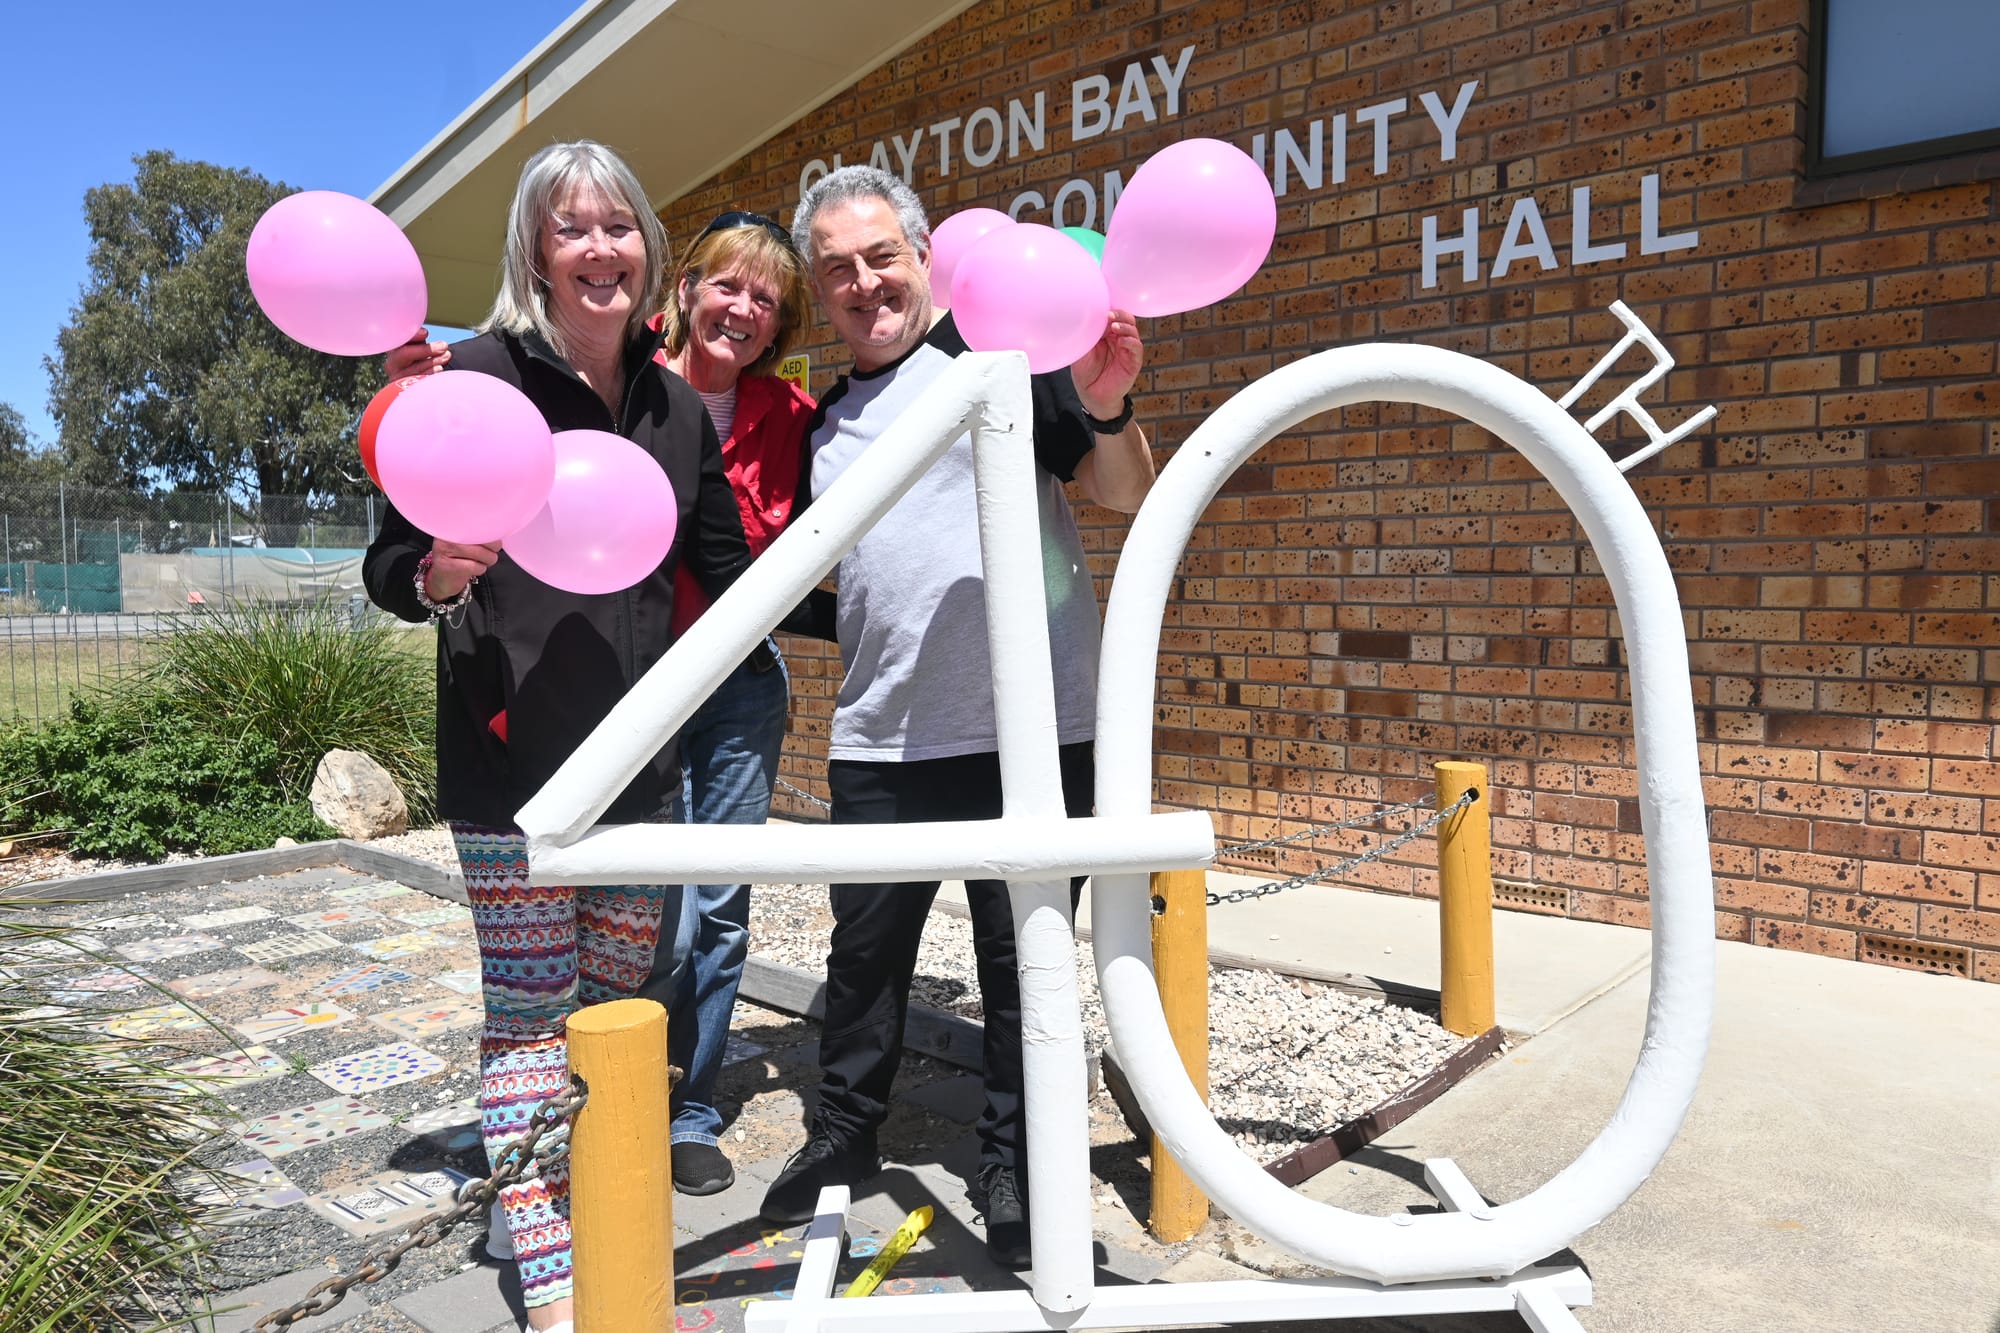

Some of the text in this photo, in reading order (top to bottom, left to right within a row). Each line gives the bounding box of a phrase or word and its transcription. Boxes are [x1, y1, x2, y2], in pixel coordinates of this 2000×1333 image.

[800, 45, 1196, 200] CAYTON BAY
[1008, 80, 1479, 233] CONITY
[1422, 174, 1699, 289] HALL
[782, 361, 802, 376] AED
